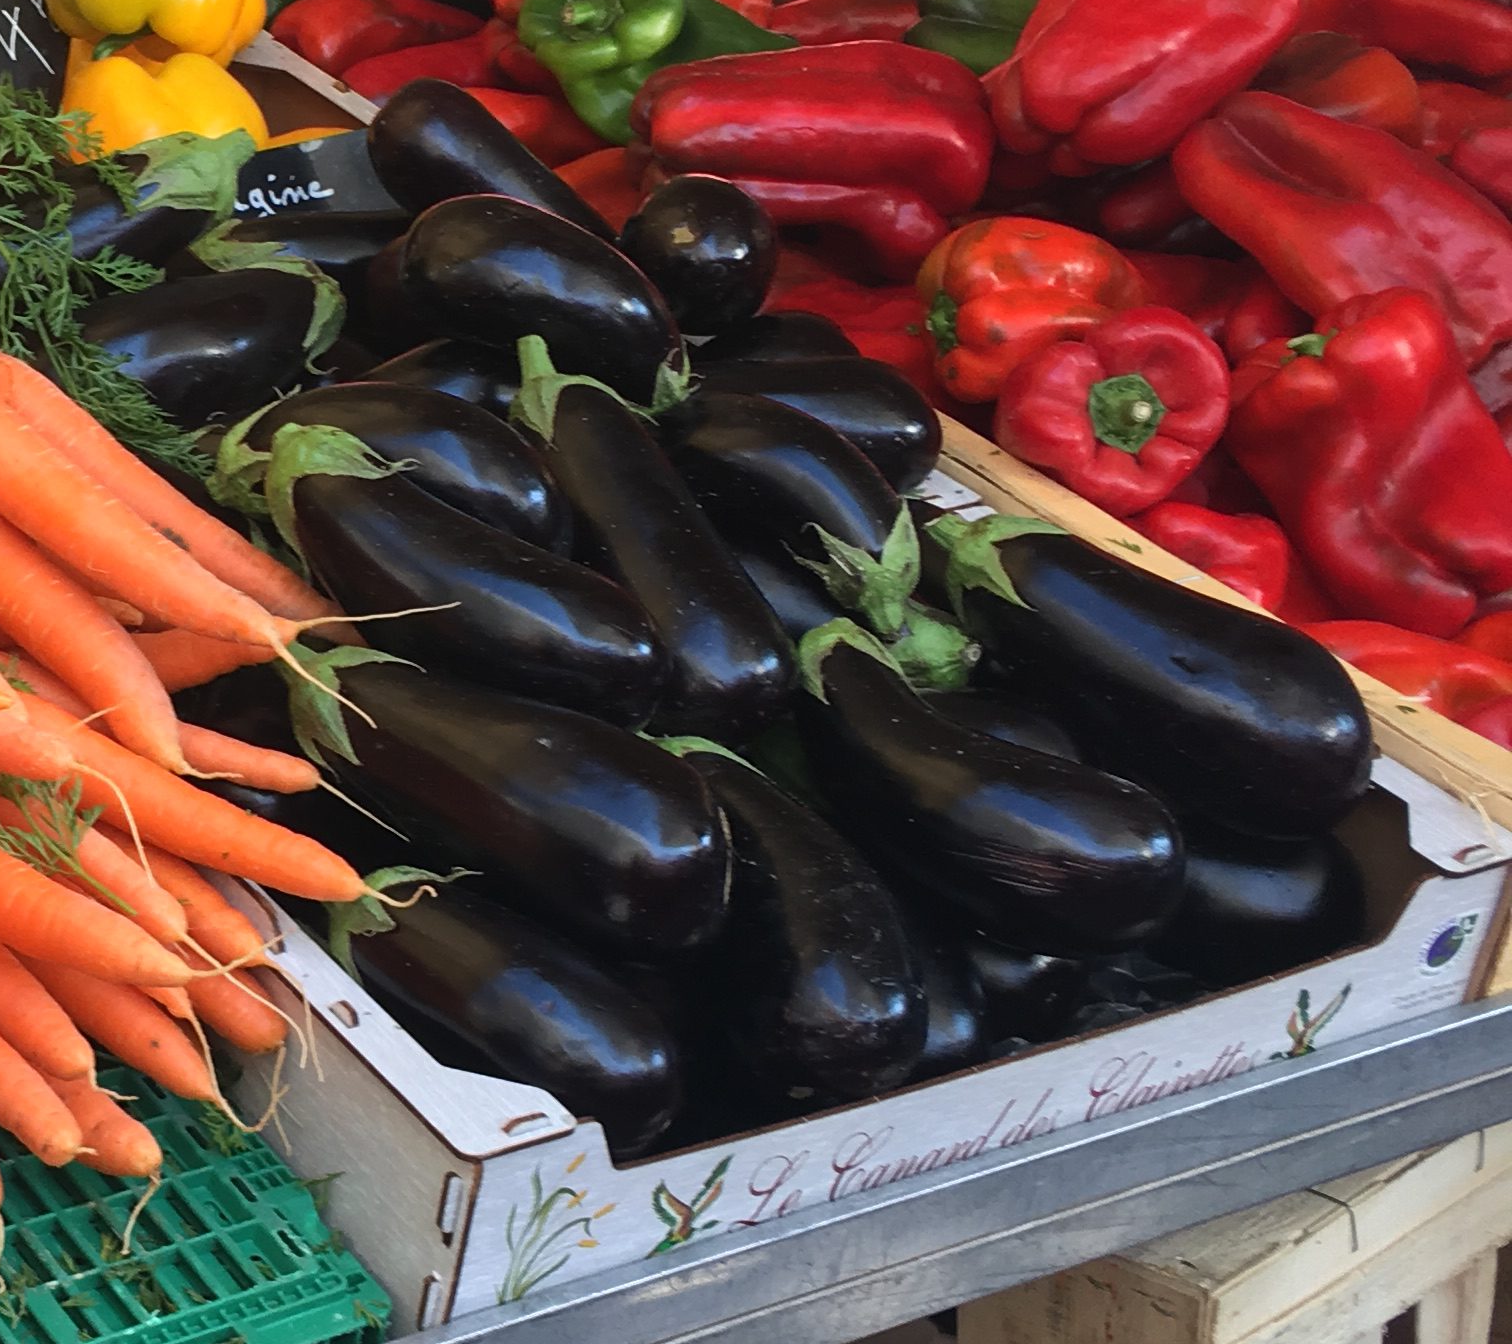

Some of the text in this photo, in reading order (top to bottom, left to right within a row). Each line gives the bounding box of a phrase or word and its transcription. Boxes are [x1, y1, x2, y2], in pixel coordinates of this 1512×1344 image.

[728, 1040, 1264, 1234] Le Canard des Clairettes
